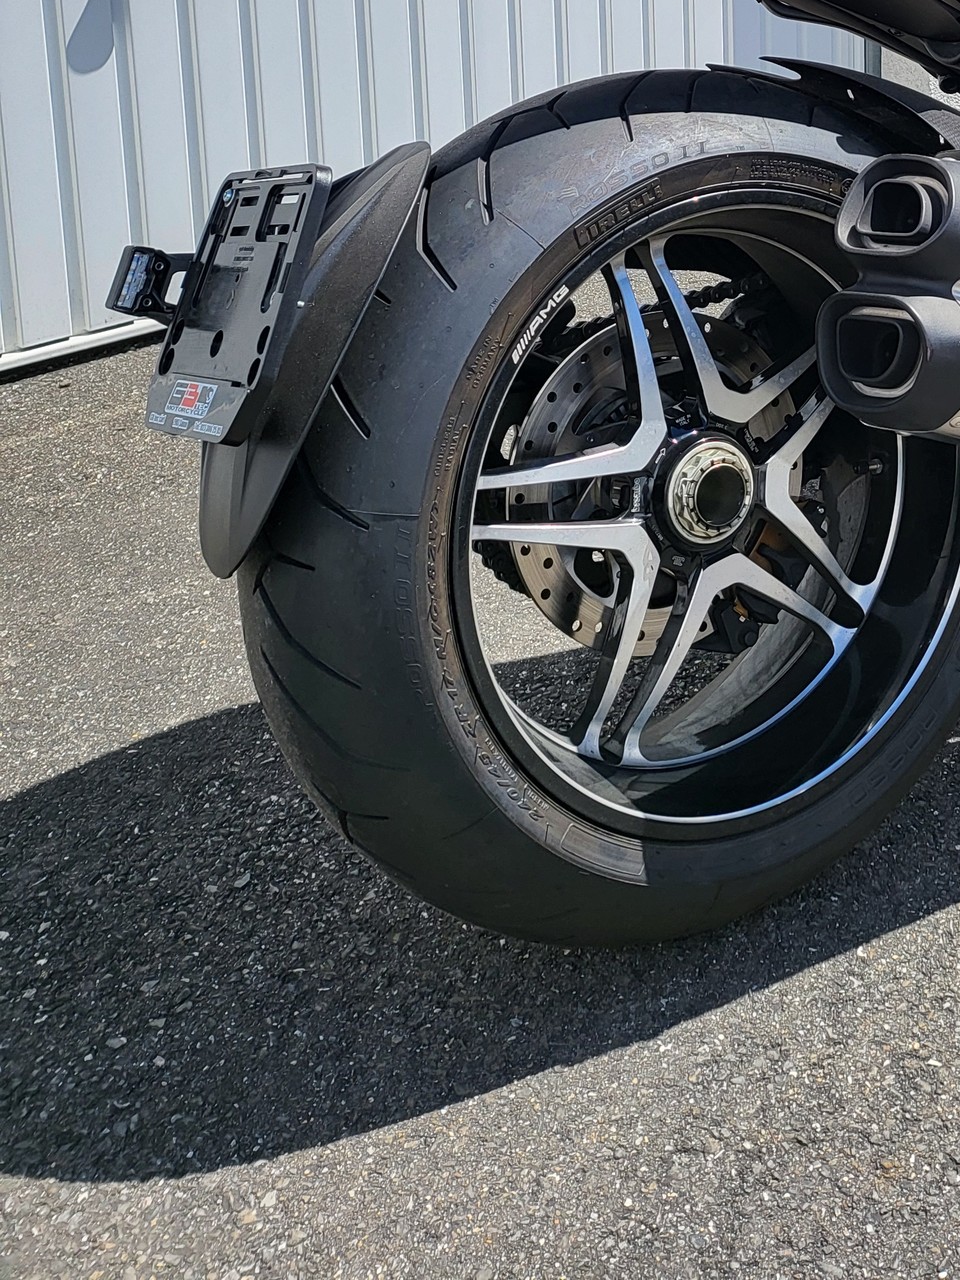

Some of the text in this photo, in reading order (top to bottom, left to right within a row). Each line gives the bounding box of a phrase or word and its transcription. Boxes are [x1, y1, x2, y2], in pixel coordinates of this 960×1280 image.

[568, 152, 669, 218] ROSSO
[574, 177, 664, 249] PIRELLI
[530, 285, 570, 338] AMG
[466, 335, 493, 381] MADE IN
[472, 336, 501, 389] GERMANY
[166, 404, 207, 416] MOTORCYCLE
[478, 752, 545, 822] 240/45
